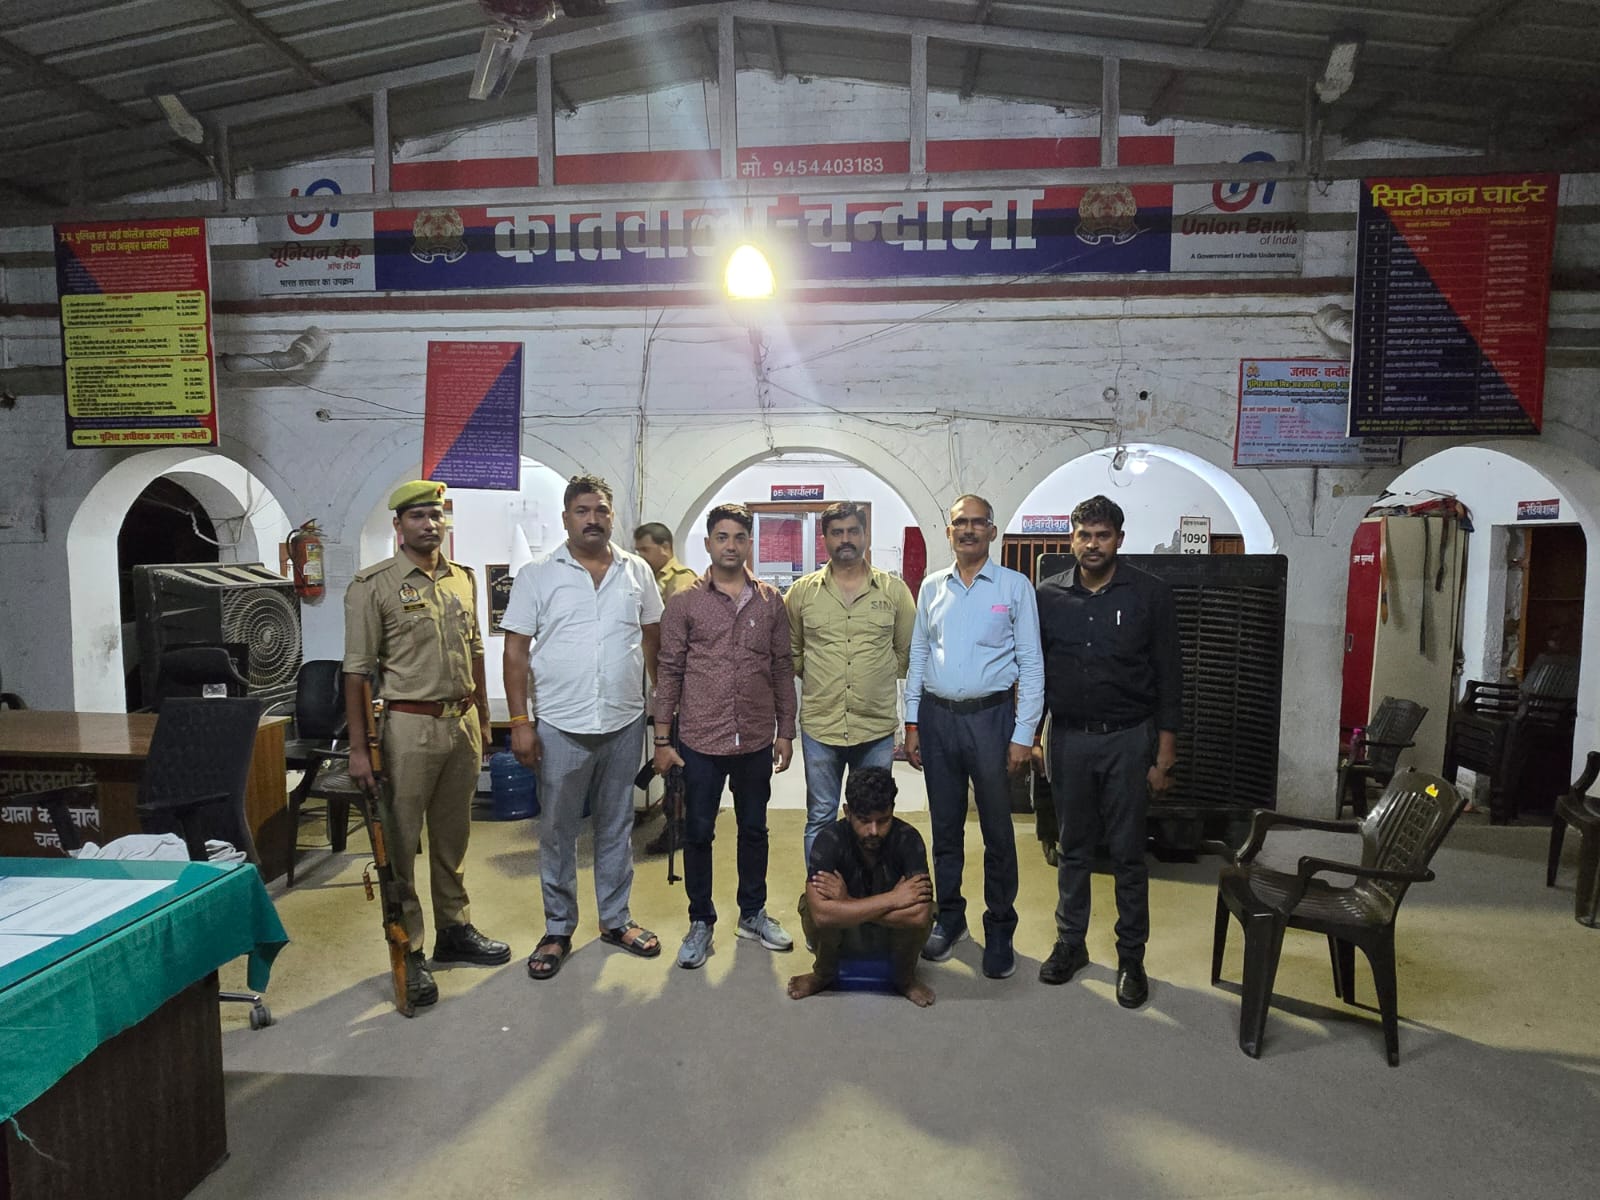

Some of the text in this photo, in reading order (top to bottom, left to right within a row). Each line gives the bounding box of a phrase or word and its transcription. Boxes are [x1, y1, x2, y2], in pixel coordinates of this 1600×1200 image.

[773, 157, 885, 175] 9454403183
[1371, 180, 1548, 207] सिटीजन चार्टर
[1181, 215, 1298, 236] Union Bank
[1259, 234, 1298, 246] of India
[270, 241, 329, 268] यूनियन
[280, 279, 297, 288] भारत
[322, 278, 331, 286] का
[787, 486, 819, 498] कार्यालय
[1182, 532, 1208, 544] 1090
[1, 806, 33, 825] थाना
